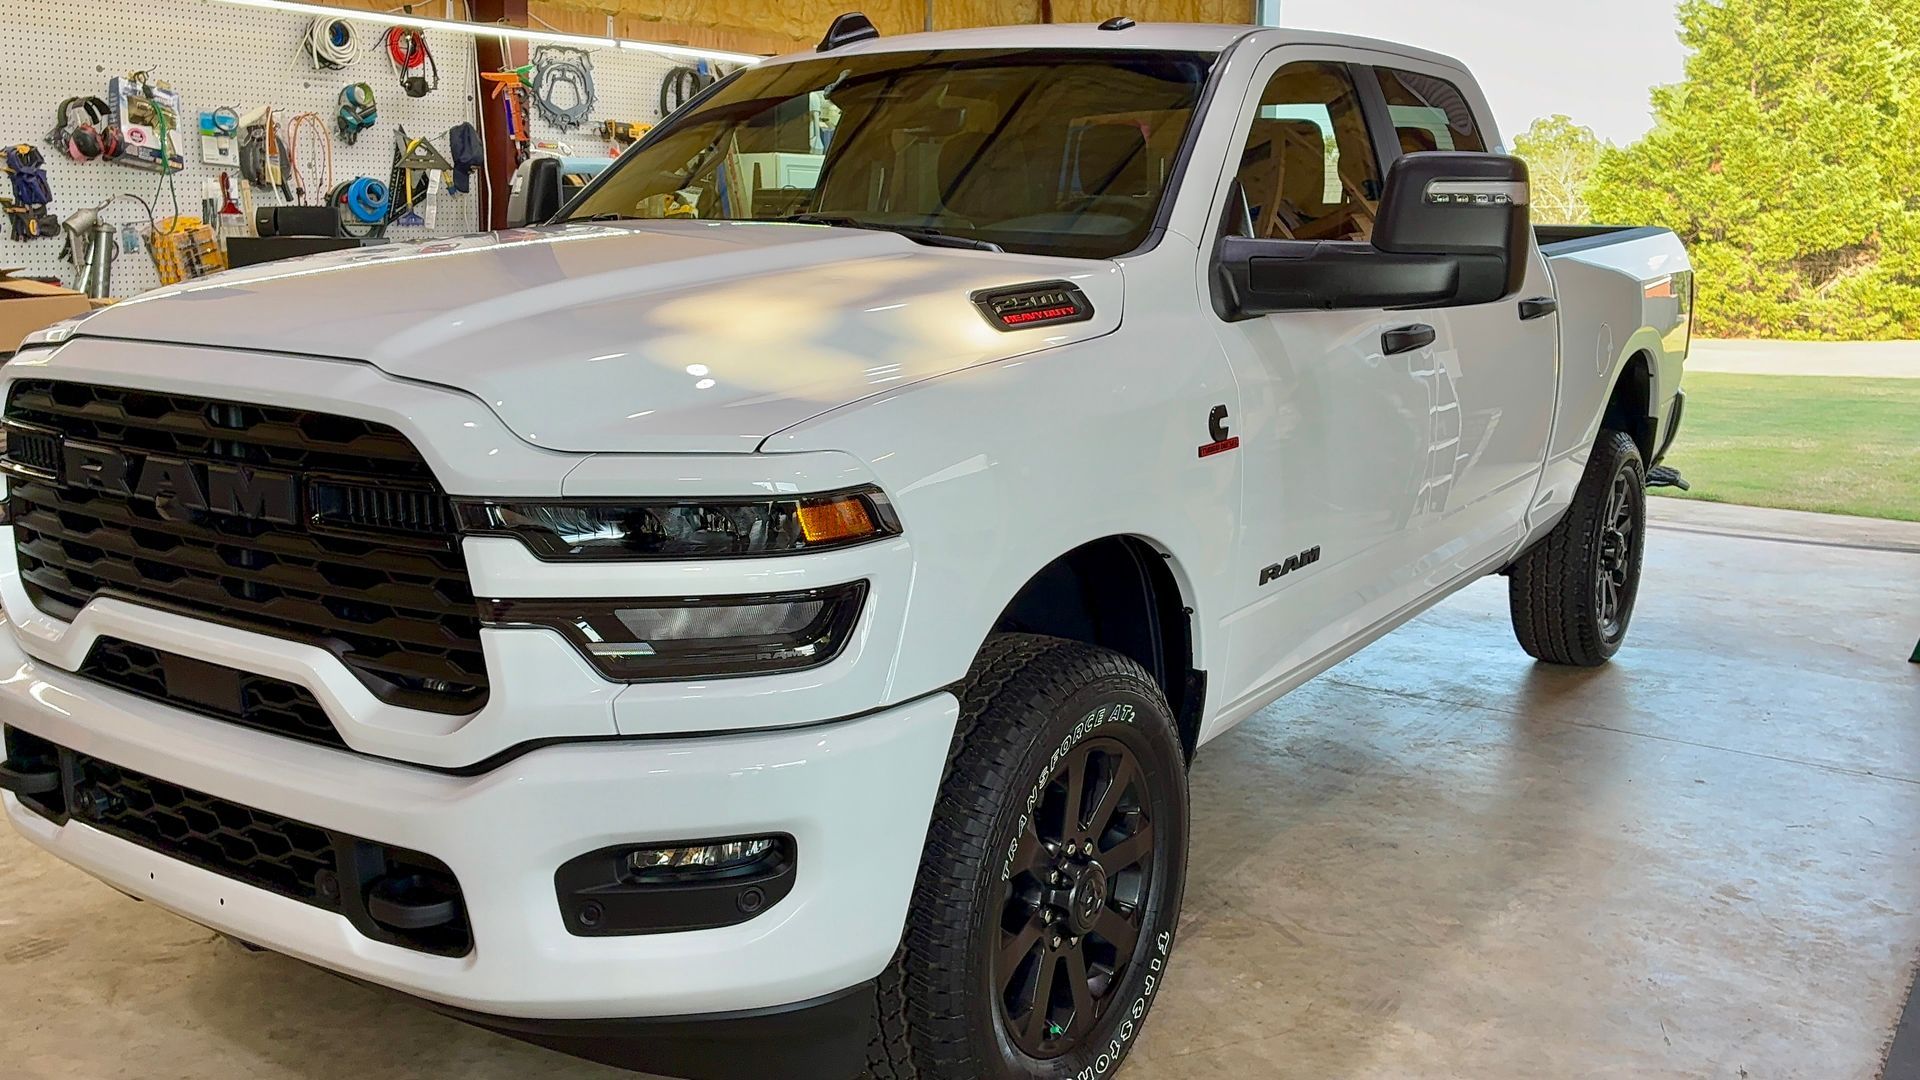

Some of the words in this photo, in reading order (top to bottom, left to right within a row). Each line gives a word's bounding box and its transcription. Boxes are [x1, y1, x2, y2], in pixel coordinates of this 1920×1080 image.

[1002, 310, 1043, 325] HEAVY
[1043, 306, 1076, 320] DUTY
[63, 440, 297, 525] RAM
[1259, 544, 1321, 586] RAM
[756, 650, 803, 661] RAM
[1000, 707, 1106, 883] TRANSFORCE
[1066, 930, 1170, 1080] Fireston
